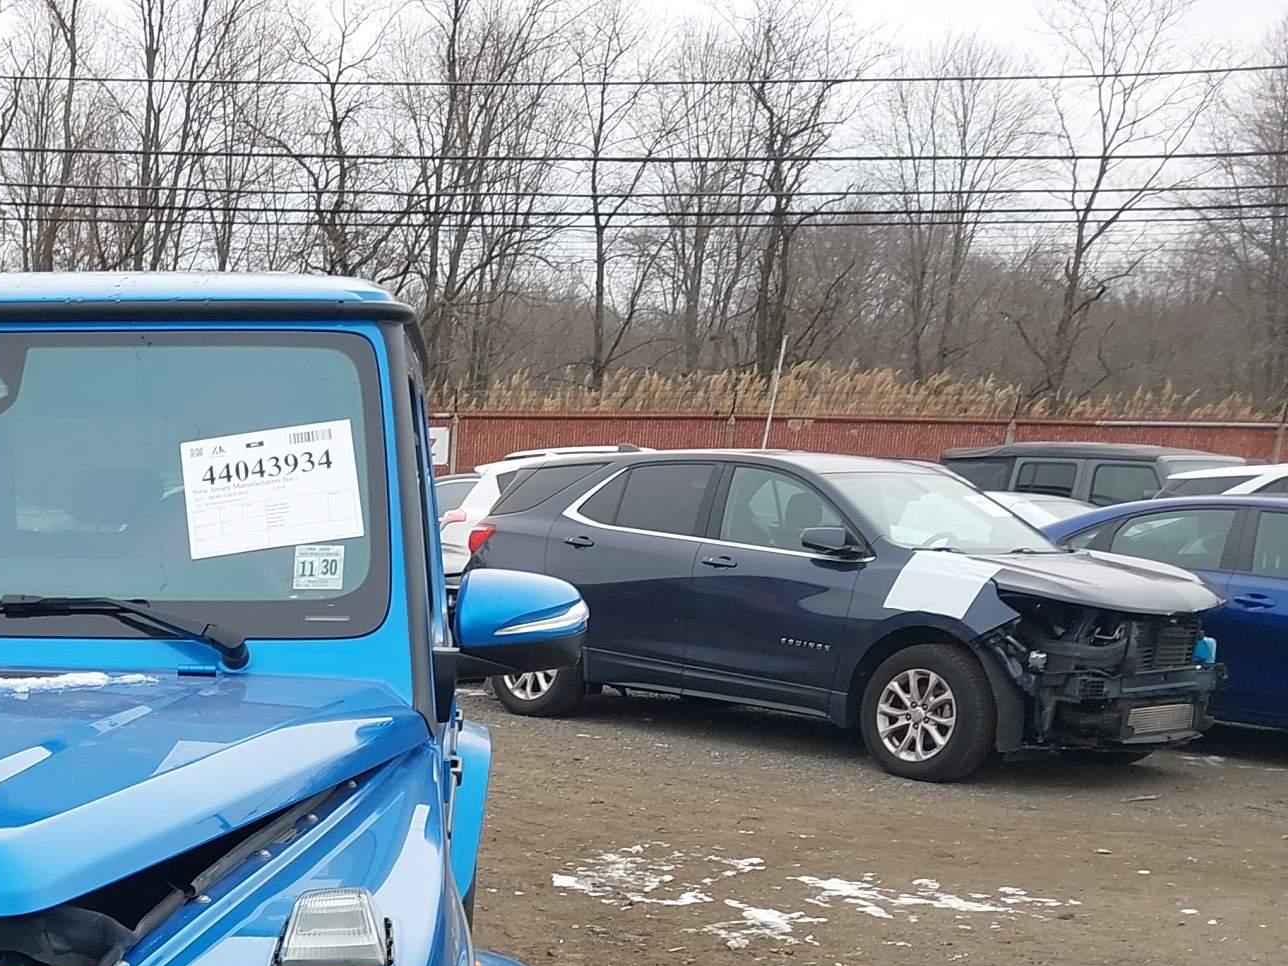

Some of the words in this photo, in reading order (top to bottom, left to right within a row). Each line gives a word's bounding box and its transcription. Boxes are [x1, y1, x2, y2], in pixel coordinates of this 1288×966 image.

[201, 448, 333, 485] 44043934
[299, 559, 316, 577] 11
[320, 558, 338, 576] 30
